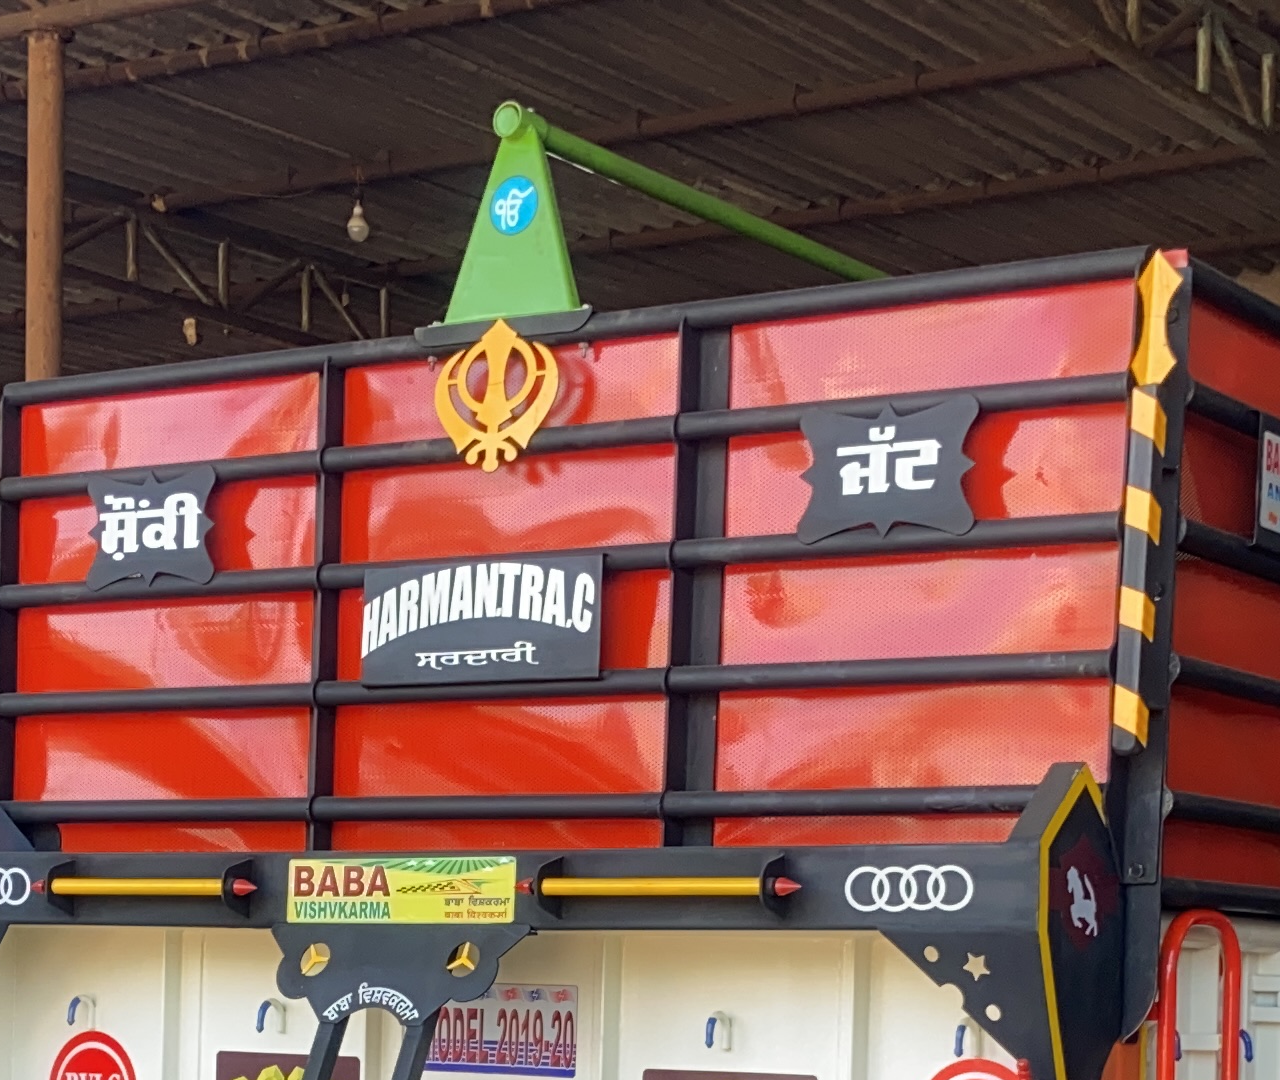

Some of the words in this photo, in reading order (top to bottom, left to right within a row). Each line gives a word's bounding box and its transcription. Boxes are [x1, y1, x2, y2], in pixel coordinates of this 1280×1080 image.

[836, 425, 943, 496] ਜੱਟ
[293, 865, 391, 897] BABA
[293, 901, 391, 920] VISHVKARMA
[496, 1008, 575, 1069] 2019-20
